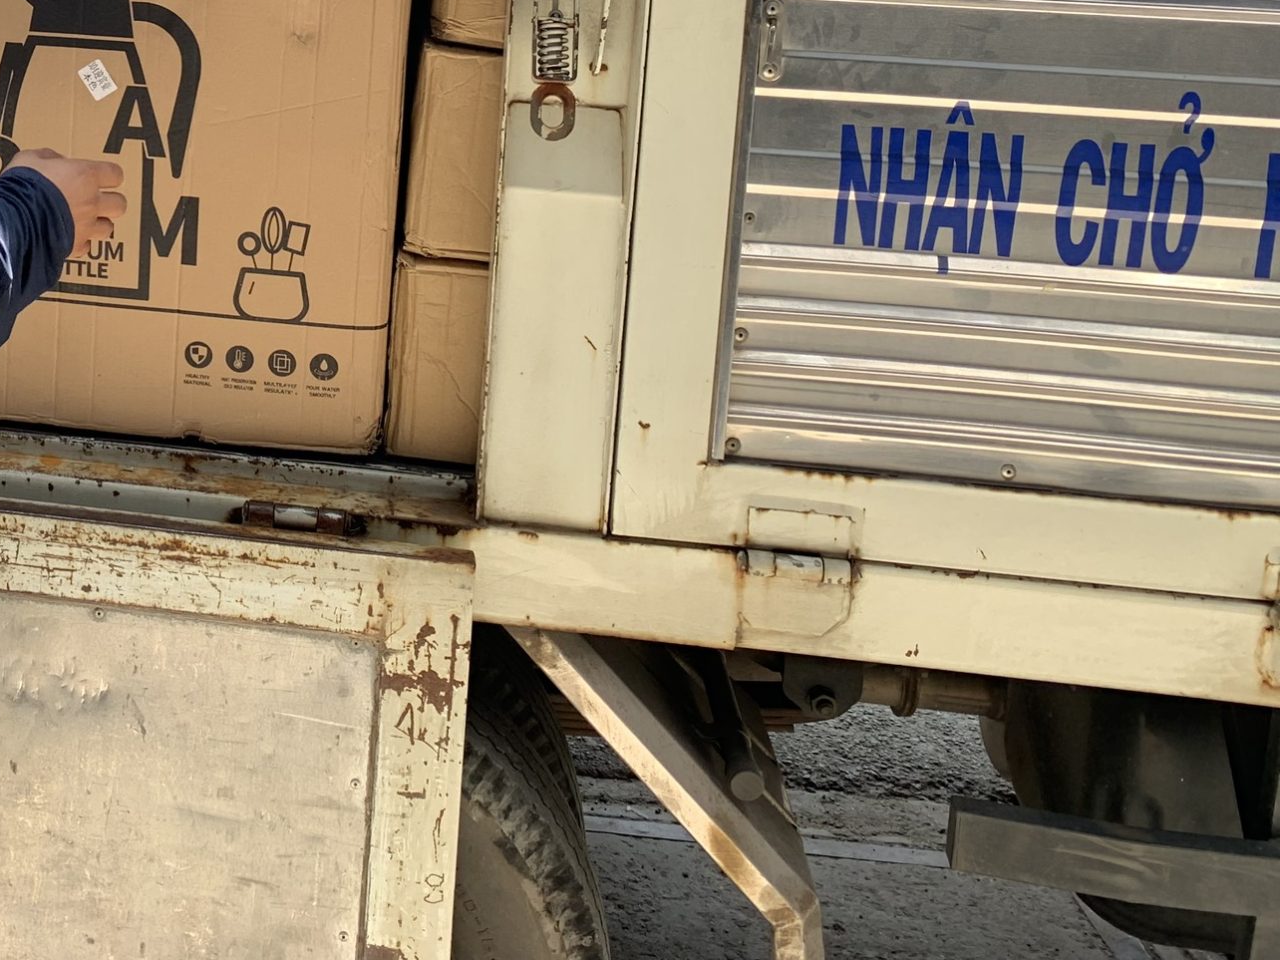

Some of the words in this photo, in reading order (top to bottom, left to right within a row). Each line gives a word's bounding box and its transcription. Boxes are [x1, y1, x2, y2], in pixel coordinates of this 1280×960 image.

[833, 101, 1025, 274] NHẬN
[1055, 91, 1215, 274] CHỞ
[64, 260, 109, 279] TTLE
